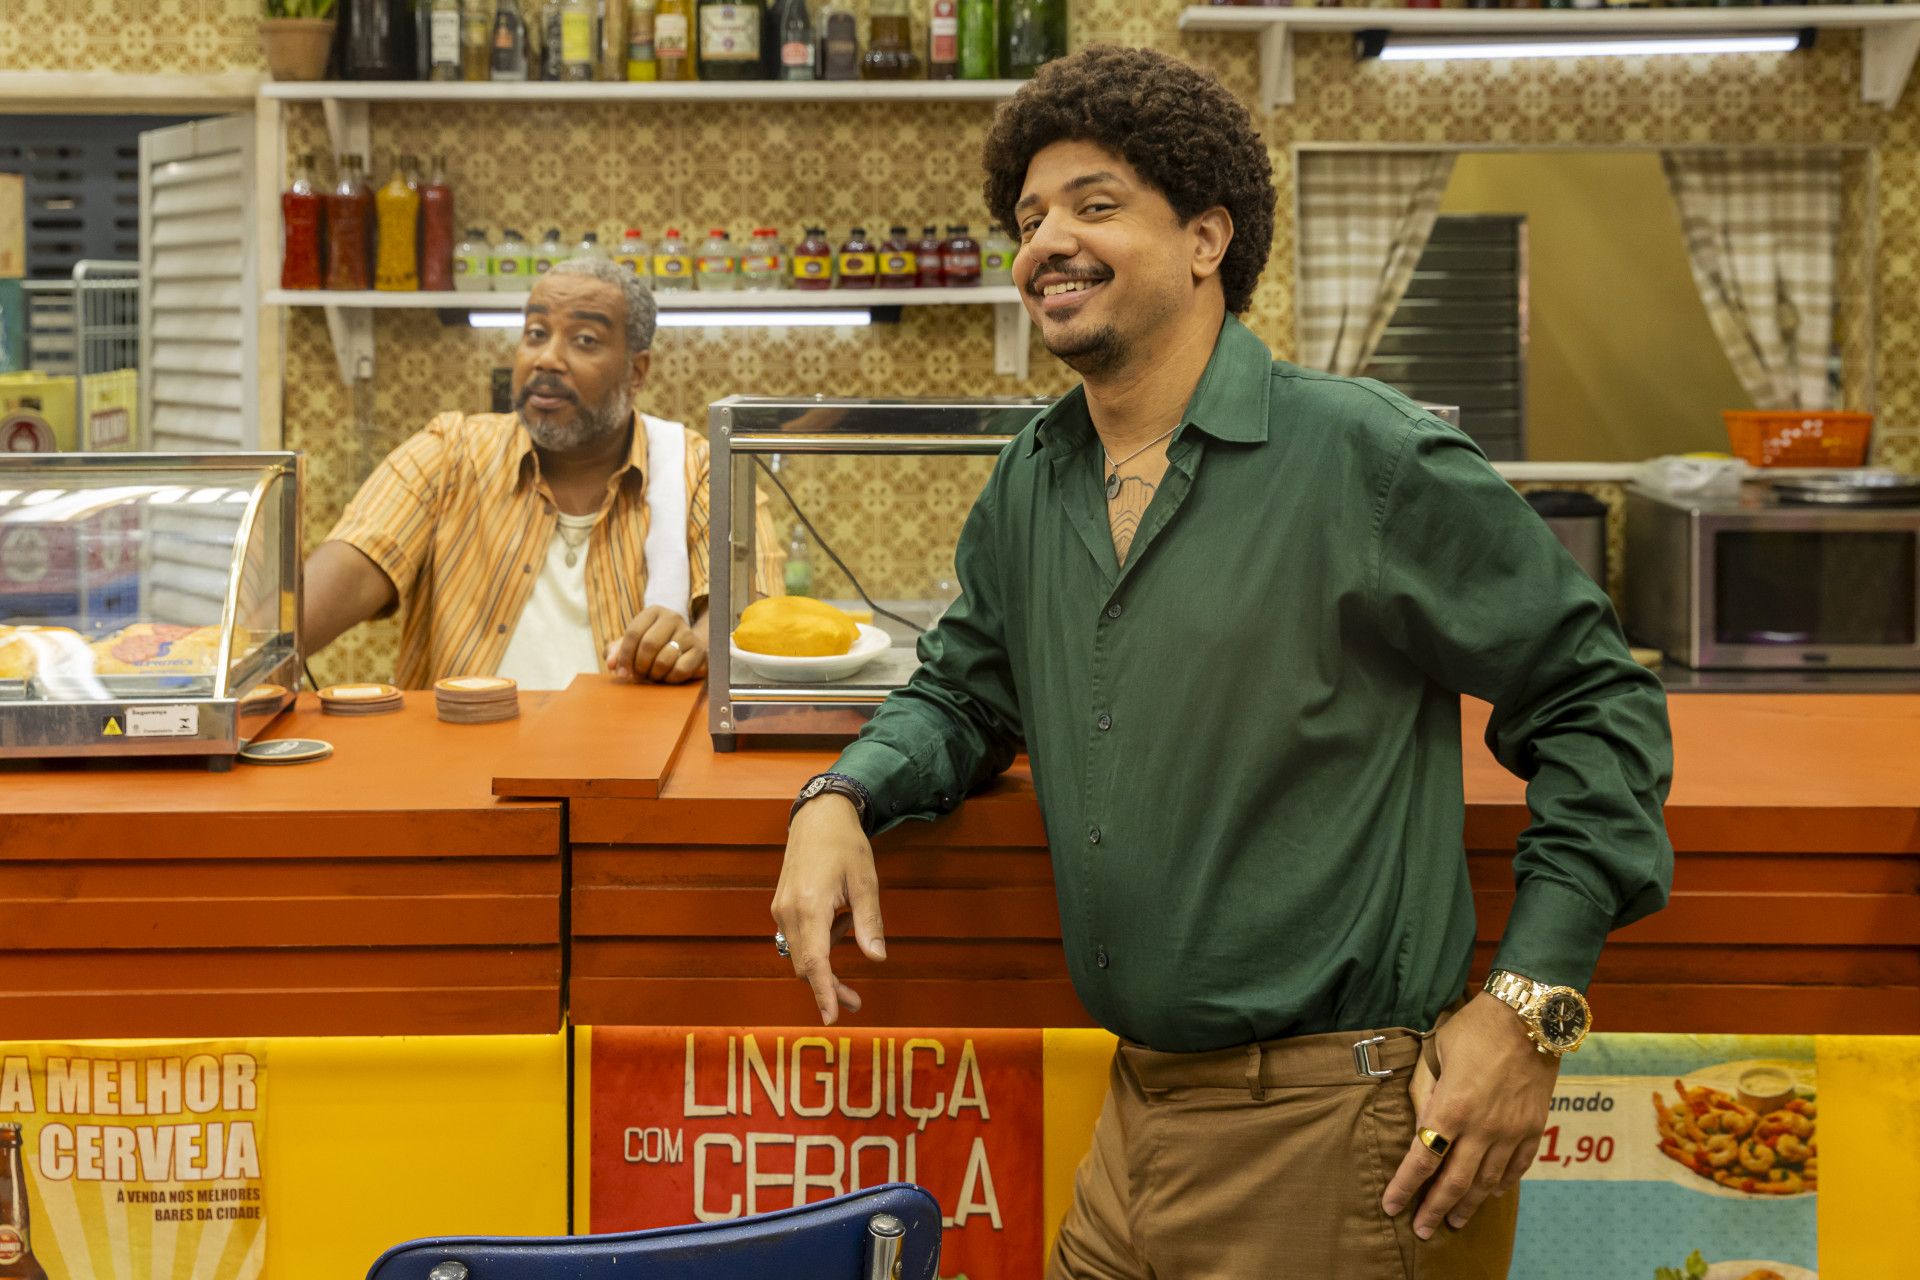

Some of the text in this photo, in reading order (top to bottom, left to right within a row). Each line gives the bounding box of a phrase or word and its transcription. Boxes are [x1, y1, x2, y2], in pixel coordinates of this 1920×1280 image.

[0, 1053, 258, 1116] A MELHOR
[684, 1033, 990, 1131] LINGUIÇA
[38, 1120, 261, 1182] CERVEJA
[624, 1127, 683, 1163] COM
[1538, 1125, 1615, 1168] 1,90
[127, 1190, 166, 1204] VENDA
[169, 1190, 194, 1203] NOS
[196, 1187, 261, 1202] MELHORES
[155, 1206, 261, 1222] BARES DA CIDADE
